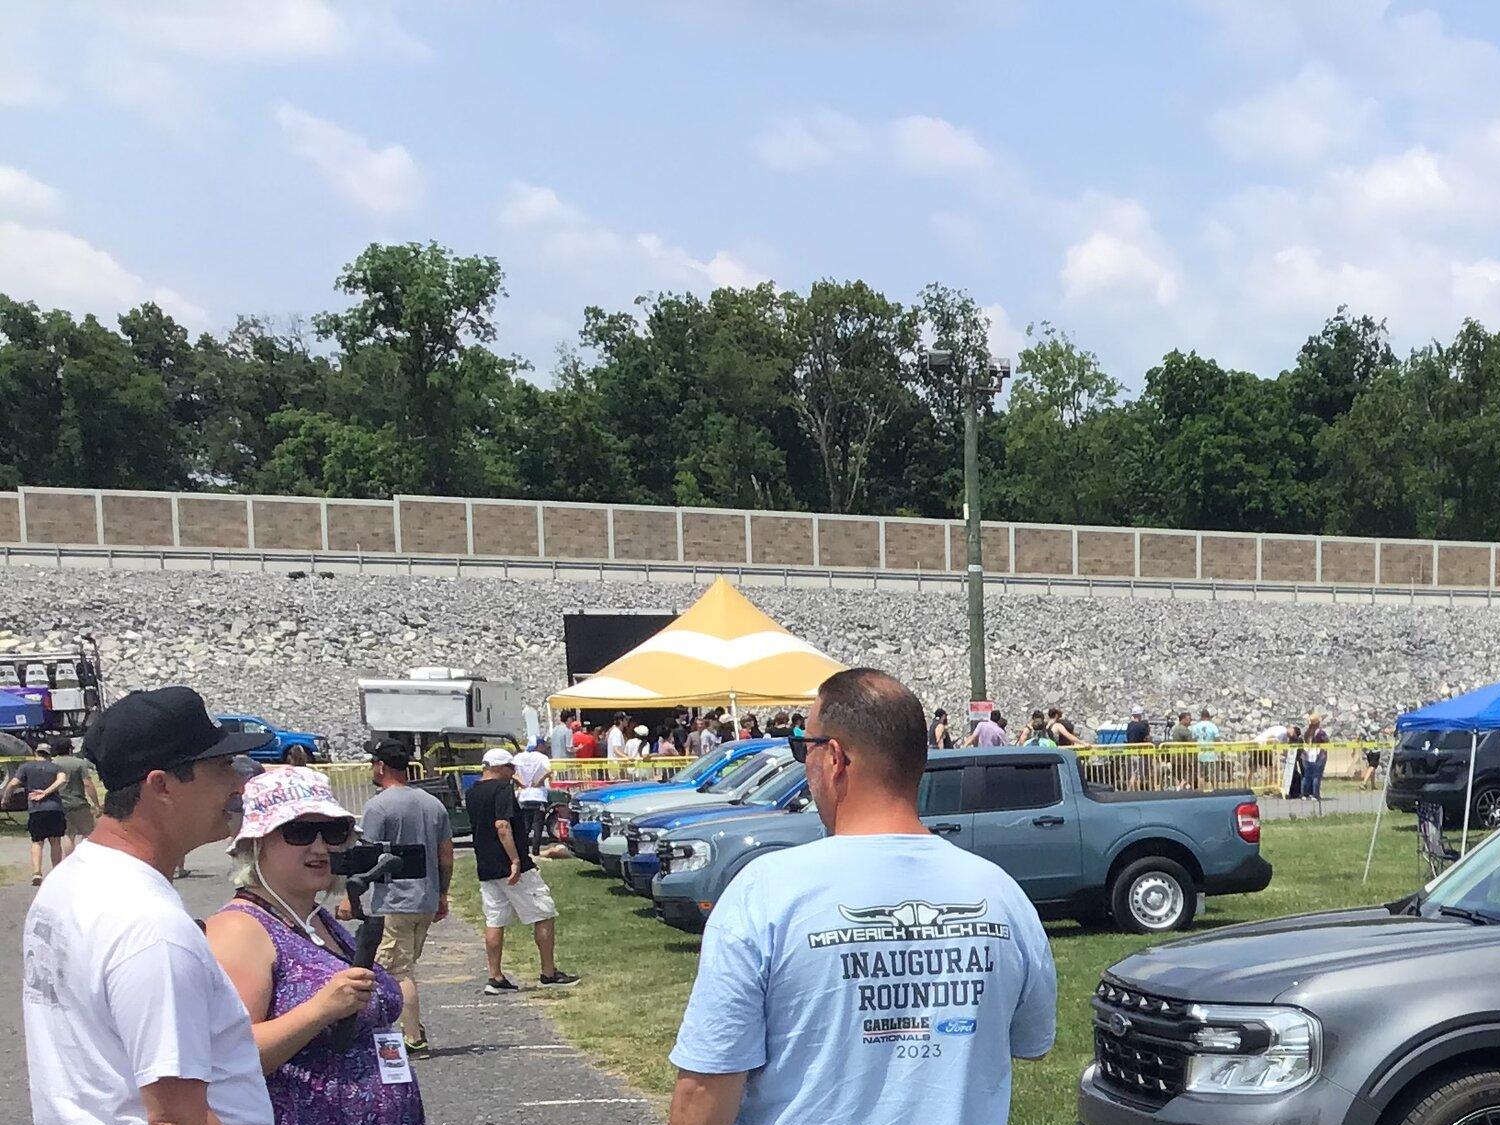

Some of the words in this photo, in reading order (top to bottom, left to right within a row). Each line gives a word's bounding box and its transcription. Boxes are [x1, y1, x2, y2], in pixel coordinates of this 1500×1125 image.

[809, 926, 907, 948] MAVERICK
[908, 924, 974, 941] TRUCK
[976, 922, 1010, 939] CLUB
[840, 945, 994, 980] INAUGURAL
[858, 979, 985, 1011] ROUNDUP
[863, 1017, 931, 1032] CARLISLE
[940, 1018, 976, 1034] Ford
[862, 1034, 931, 1044] NATIONALS
[896, 1044, 942, 1059] 2023
